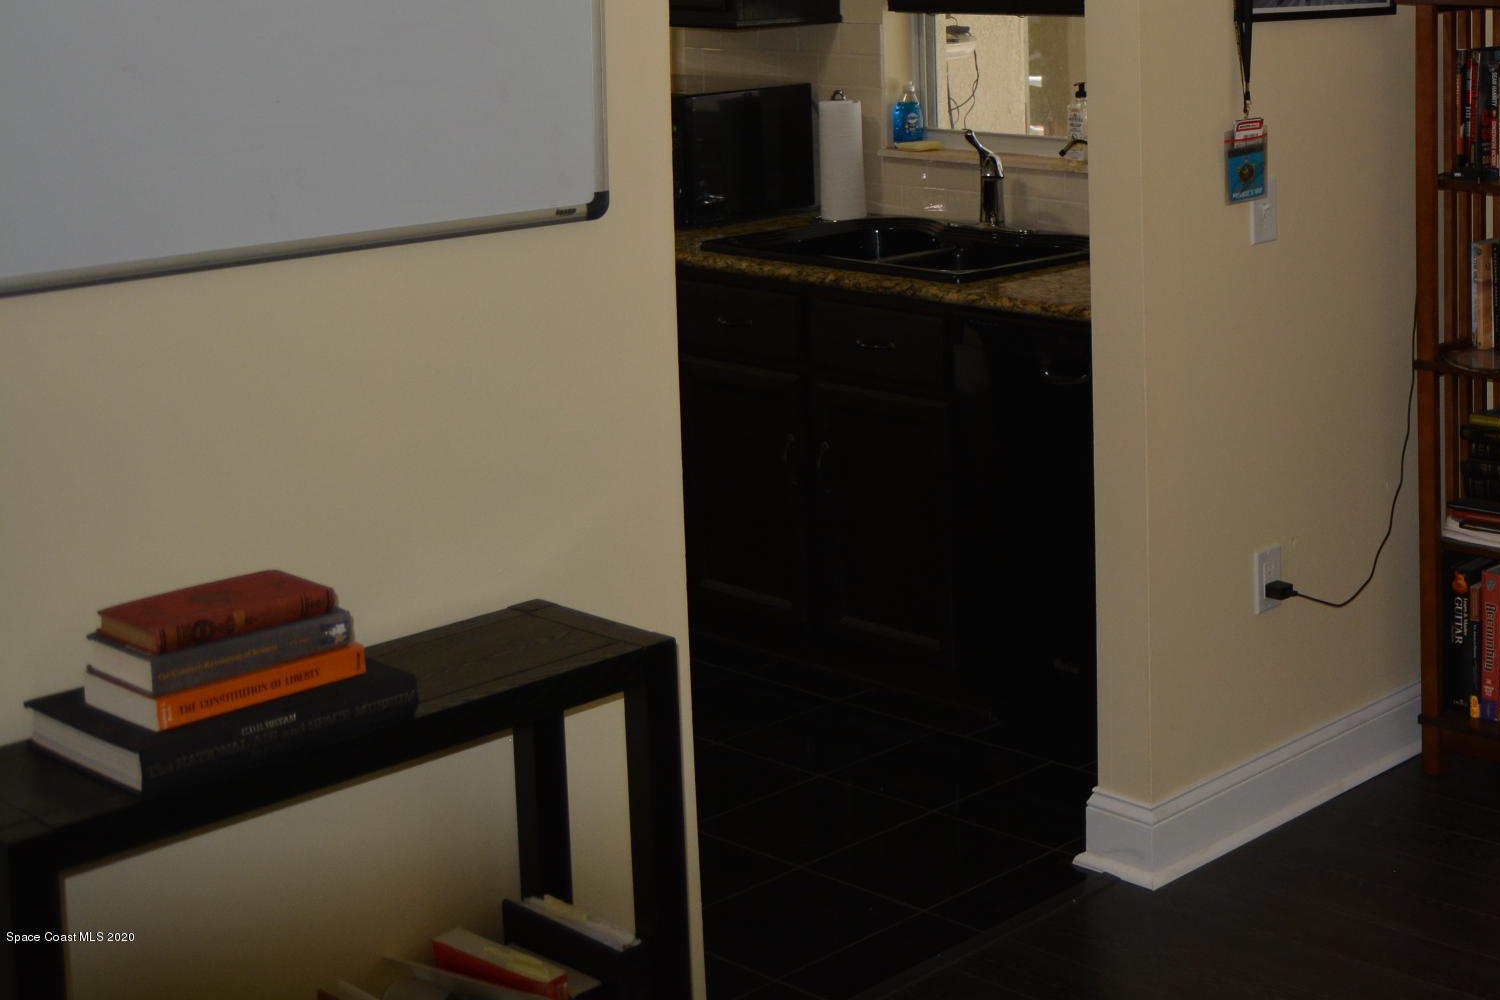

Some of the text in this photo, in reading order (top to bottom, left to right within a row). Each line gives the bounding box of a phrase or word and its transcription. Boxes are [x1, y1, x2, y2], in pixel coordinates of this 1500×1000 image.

[1454, 597, 1463, 645] GUITAR
[1484, 602, 1496, 672] Accounting
[178, 668, 320, 715] THE CONSTITUTION OF LIBERTY
